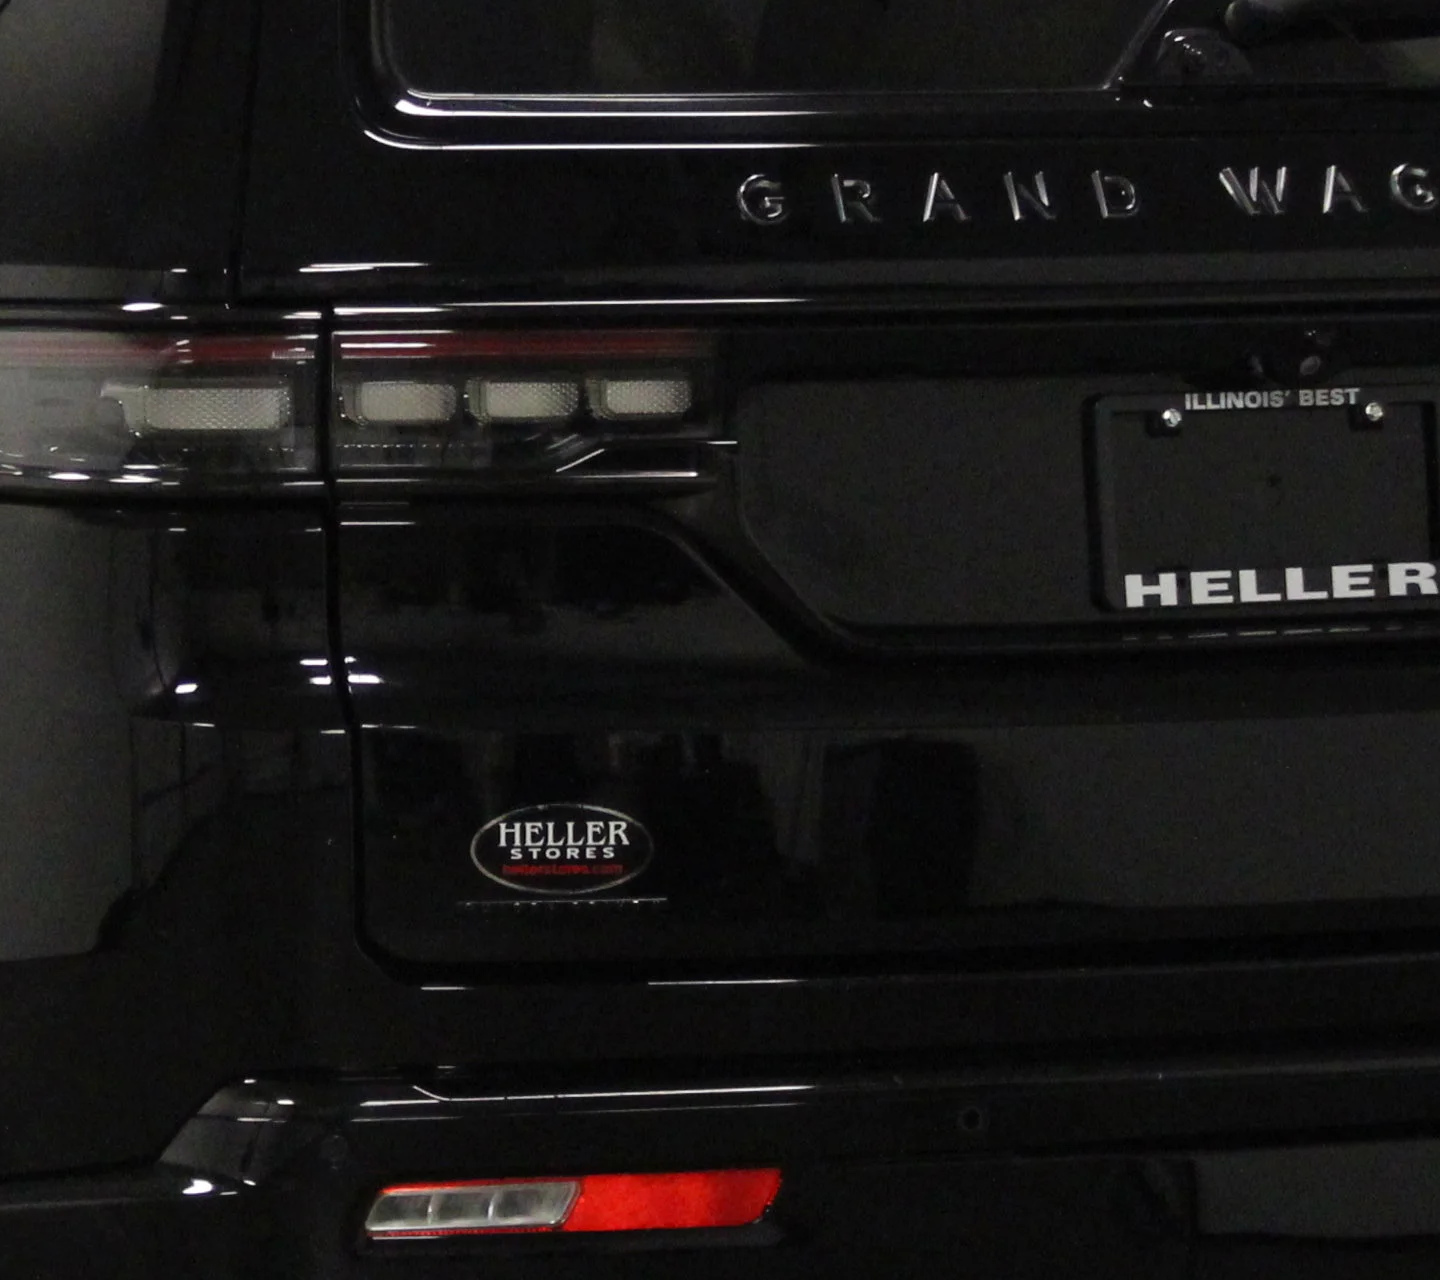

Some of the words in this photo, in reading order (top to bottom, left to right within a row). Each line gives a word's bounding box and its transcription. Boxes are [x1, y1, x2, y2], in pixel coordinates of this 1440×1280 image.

[737, 170, 1140, 224] GRAND
[1298, 387, 1361, 406] BEST
[1124, 562, 1439, 609] HELLER
[498, 821, 630, 847] HELLER
[510, 847, 615, 860] STORES
